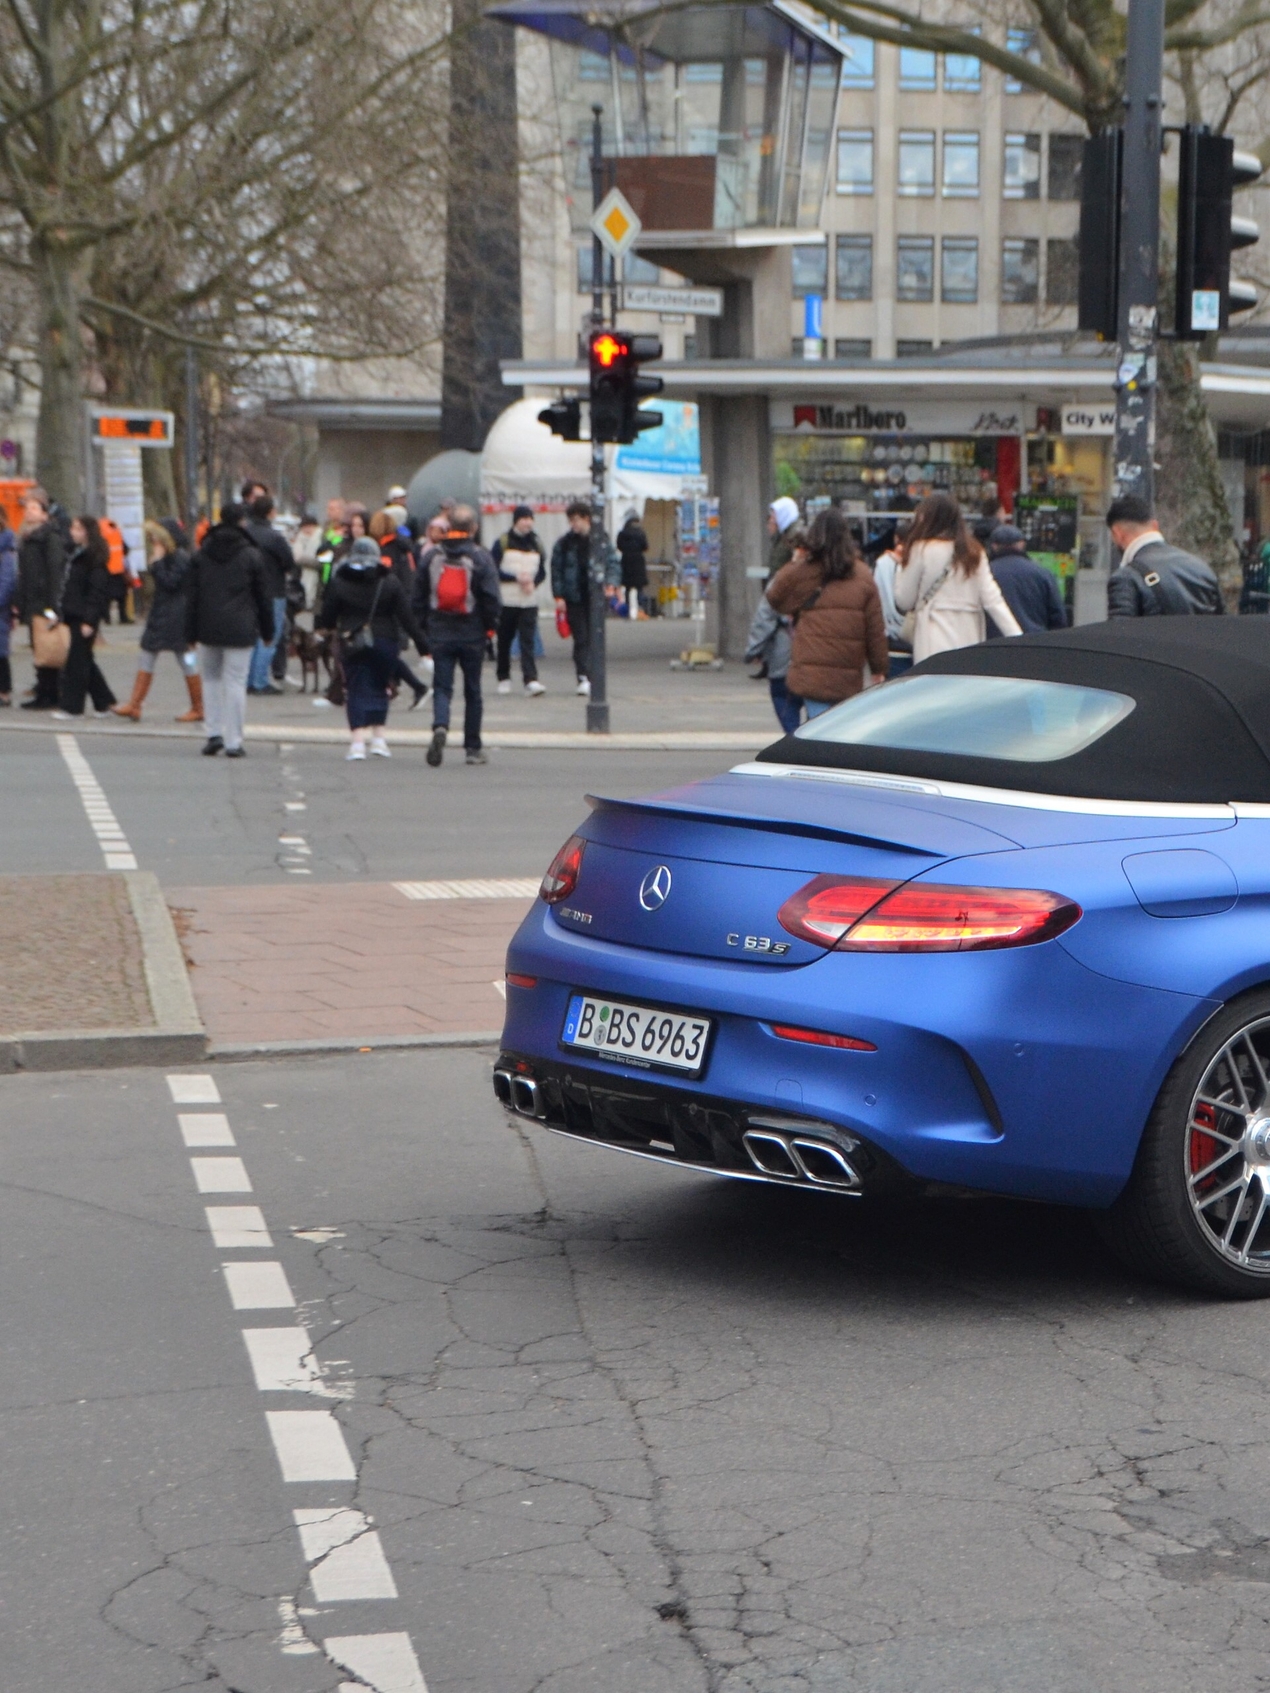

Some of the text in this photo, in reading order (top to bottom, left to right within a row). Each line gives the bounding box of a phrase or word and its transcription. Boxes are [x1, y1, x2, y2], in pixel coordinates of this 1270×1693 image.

[626, 290, 717, 308] Kurfürstendamm
[819, 404, 907, 430] Marlboro
[1066, 411, 1095, 427] City
[727, 933, 739, 946] C
[744, 936, 771, 950] 63
[567, 1023, 575, 1034] D
[578, 1003, 596, 1039] B
